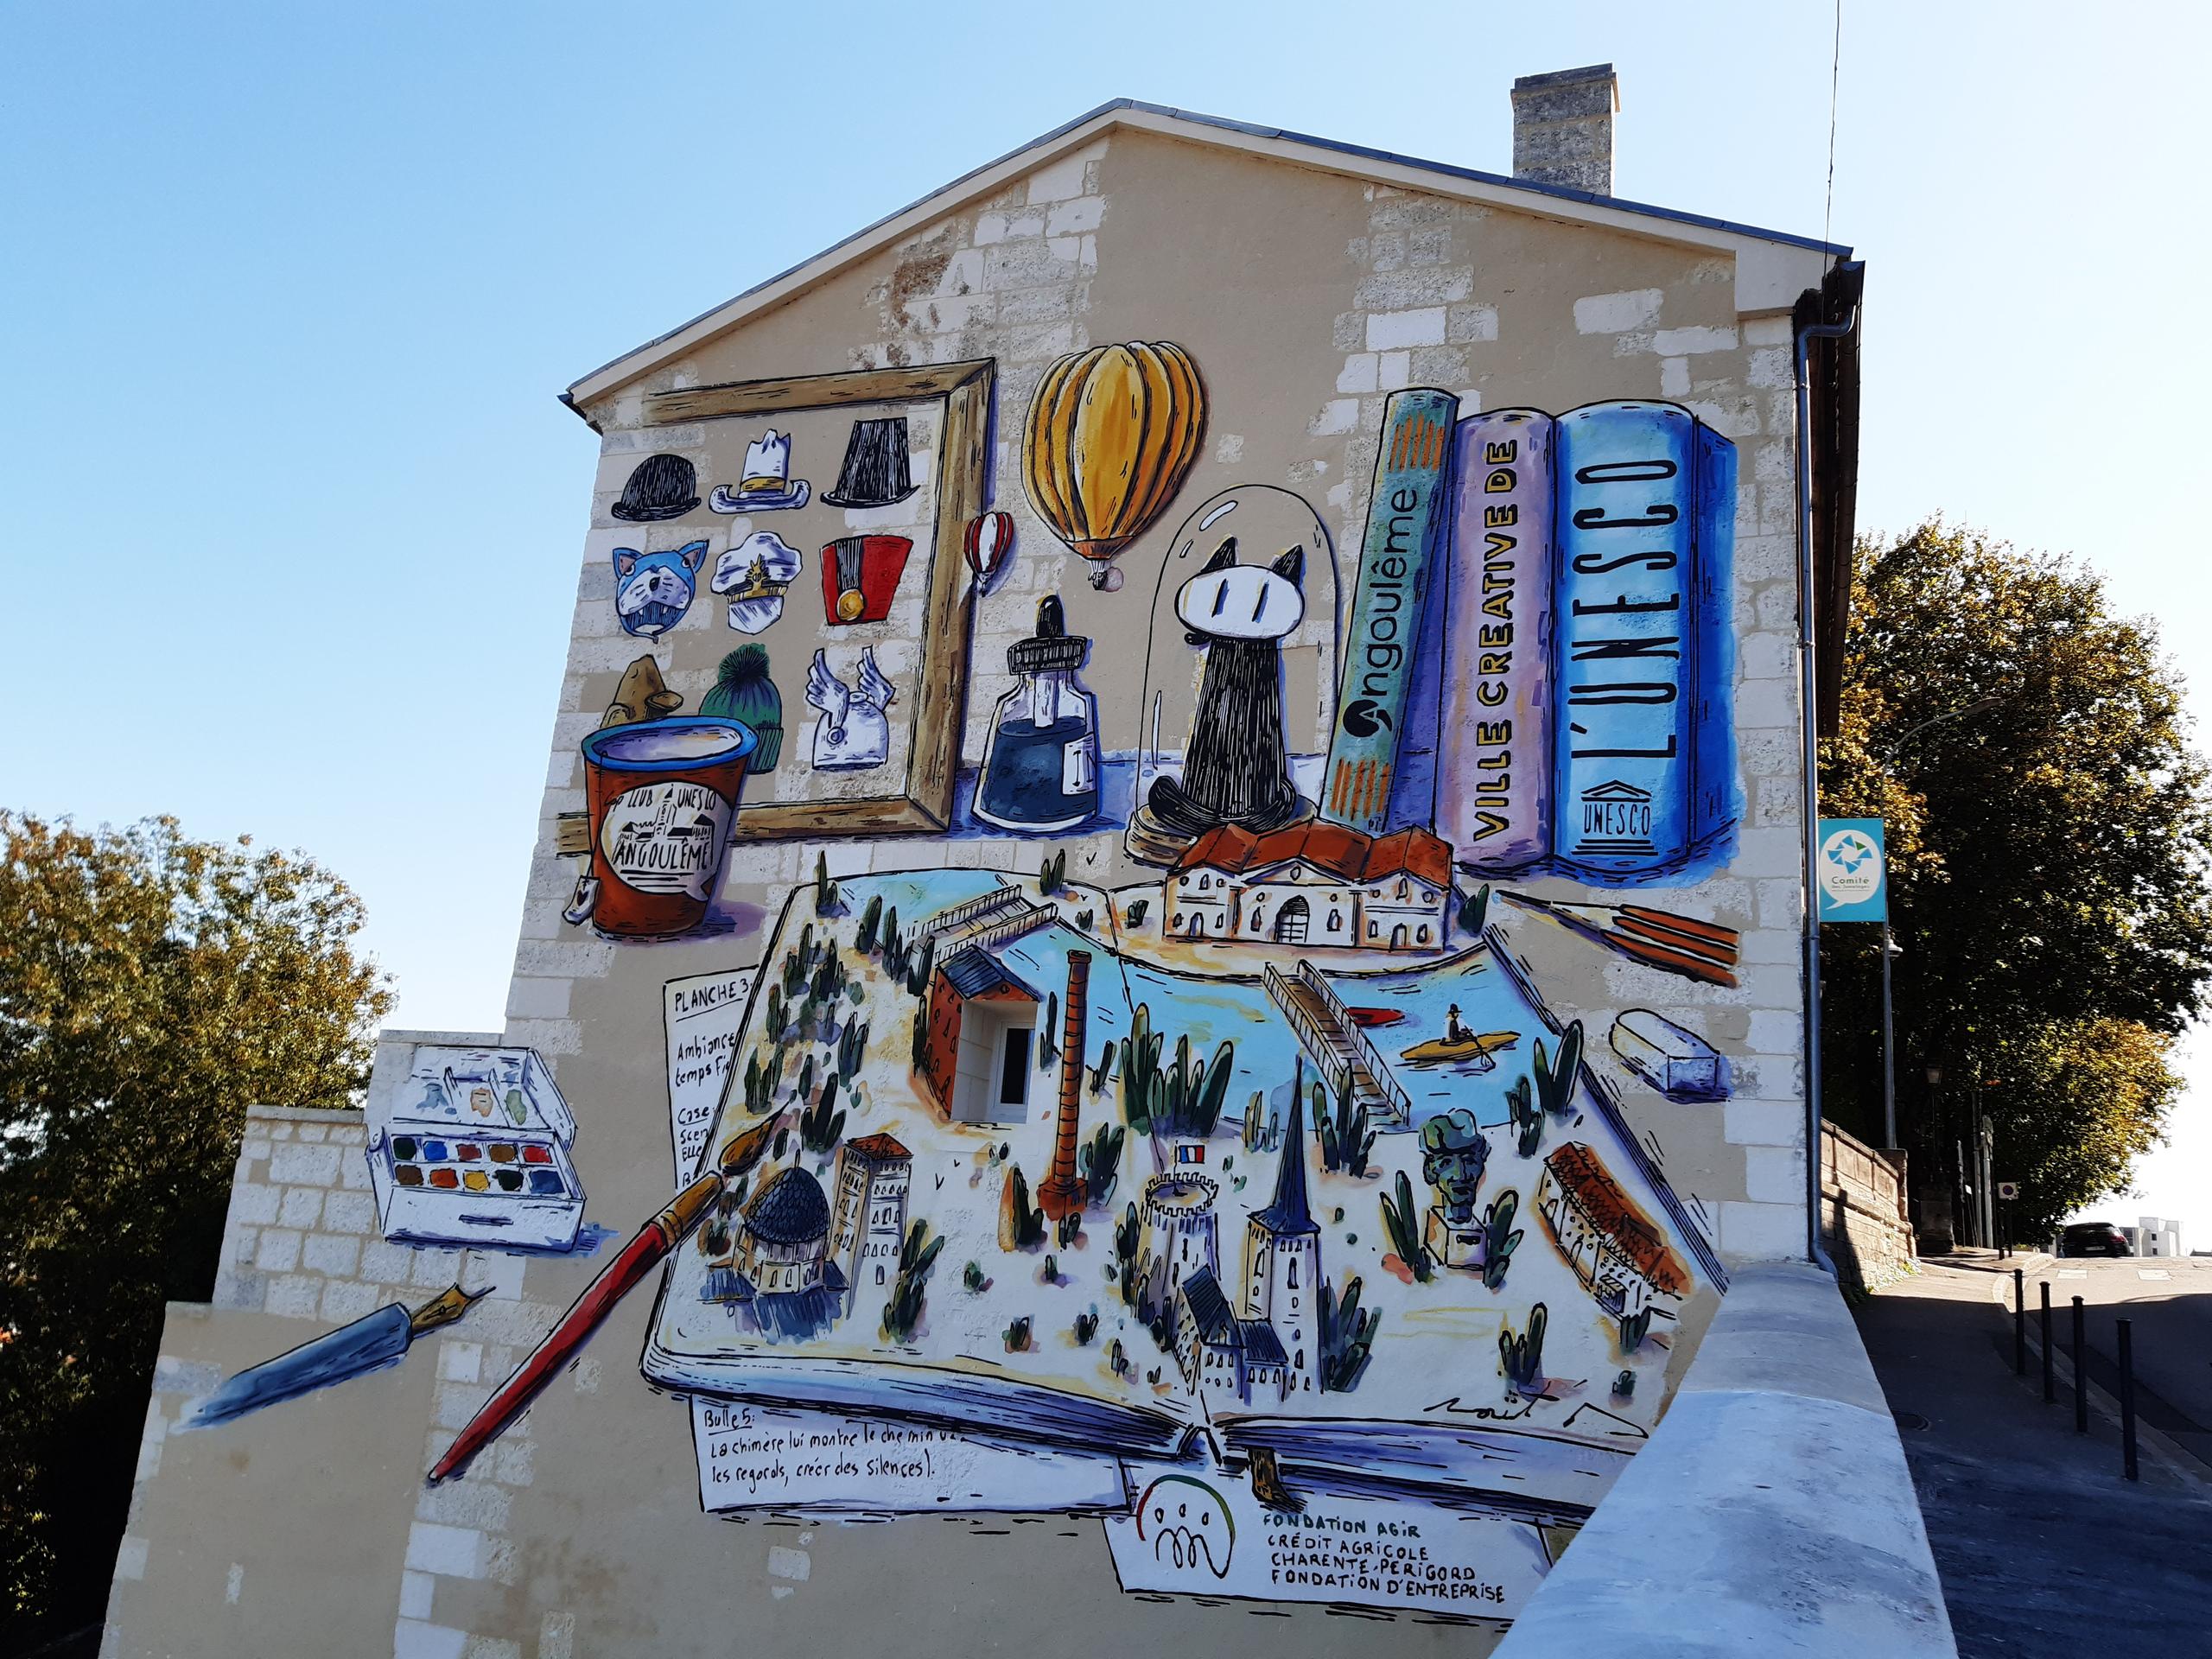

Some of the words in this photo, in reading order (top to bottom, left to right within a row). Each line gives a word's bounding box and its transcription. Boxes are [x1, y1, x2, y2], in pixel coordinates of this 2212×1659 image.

[1484, 438, 1518, 494] DE
[1477, 503, 1519, 708] CREATIVE
[1567, 459, 1680, 760] L'UNESCO
[1473, 720, 1513, 842] VILLE
[1584, 803, 1650, 836] UNESCO
[612, 836, 710, 870] ANGOULÊME
[675, 982, 736, 1012] PLANCHE
[676, 1064, 712, 1087] temps
[704, 1408, 740, 1430] Bulle
[732, 1431, 784, 1454] chimère
[789, 1430, 804, 1449] lui
[810, 1427, 858, 1448] montre
[712, 1465, 730, 1483] les
[835, 1451, 859, 1477] des
